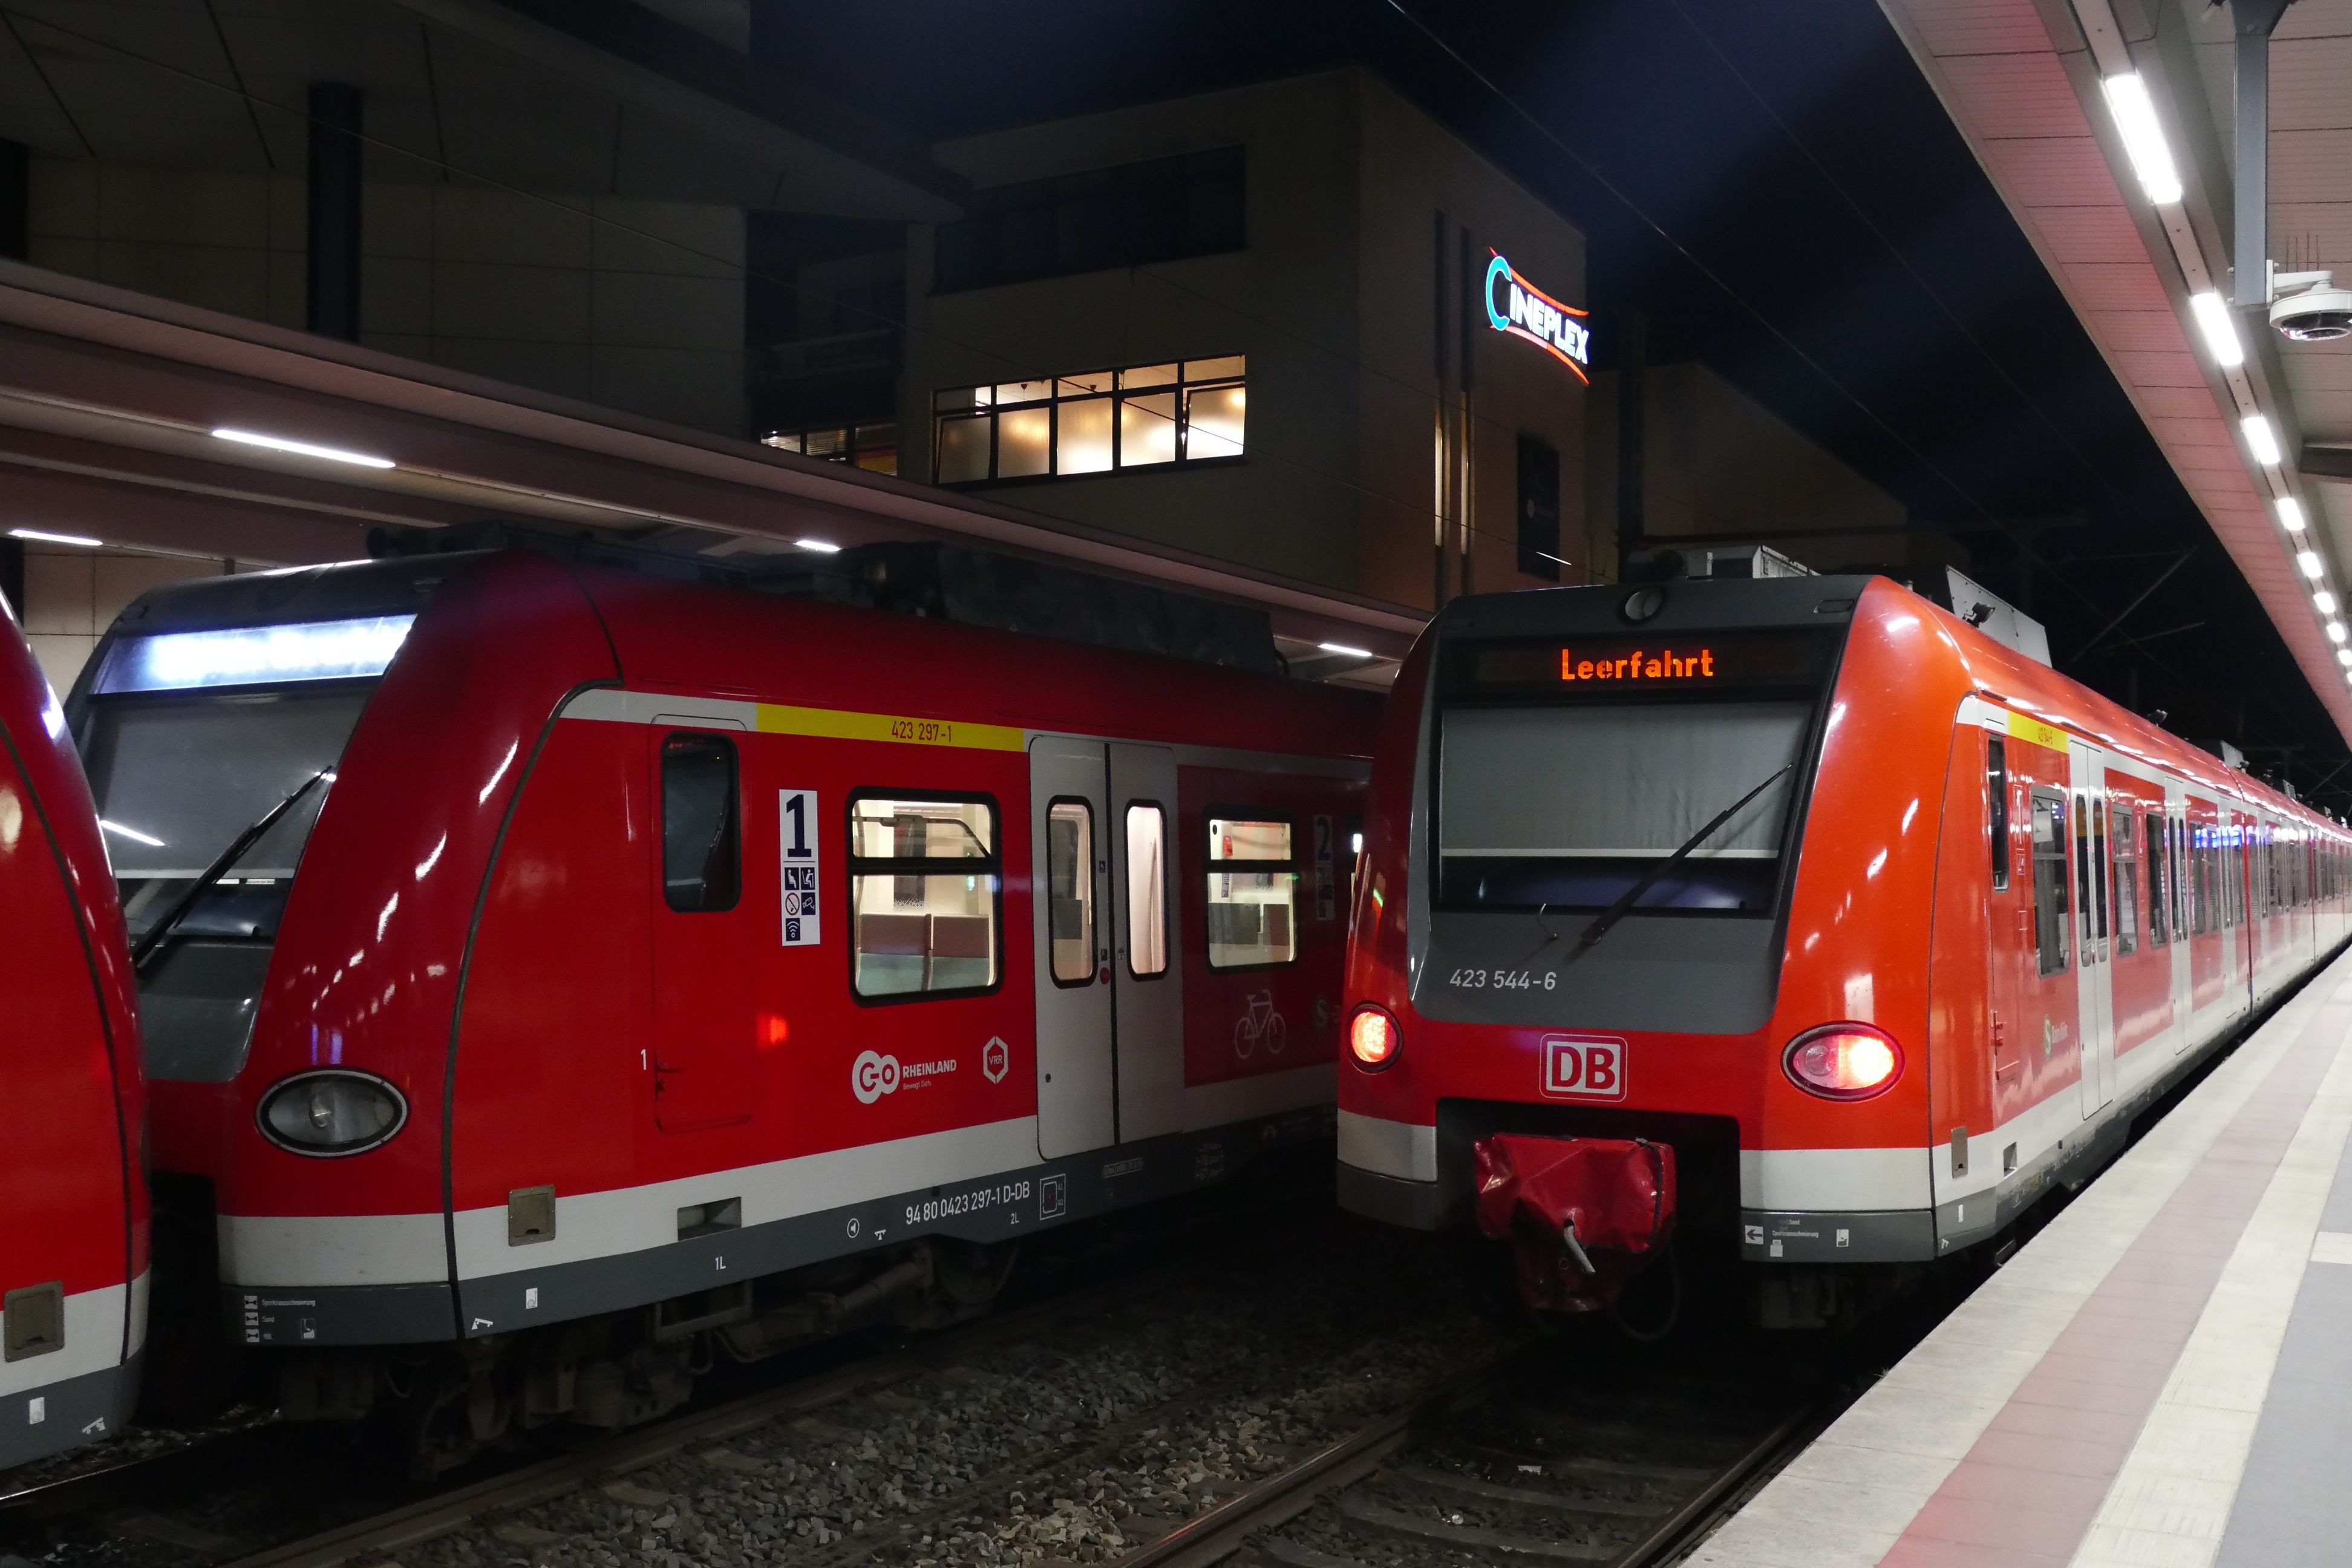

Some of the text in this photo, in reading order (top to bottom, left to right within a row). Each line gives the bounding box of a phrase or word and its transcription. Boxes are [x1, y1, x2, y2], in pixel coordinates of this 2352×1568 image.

[1485, 255, 1589, 364] CINEPLEX
[1562, 648, 1713, 680] Leerfahrt
[892, 720, 951, 743] 423 297-1
[786, 794, 811, 857] 1
[1318, 817, 1330, 861] 2
[1449, 969, 1557, 990] 423 544-6
[641, 1049, 647, 1070] 1
[903, 1059, 957, 1079] RHEINLAND
[988, 1054, 1002, 1065] VRR
[1551, 1045, 1616, 1089] DB
[906, 1181, 1030, 1225] 94 80 0423 297-1 D-DB
[1010, 1212, 1019, 1224] 2L
[715, 1256, 726, 1270] 1L
